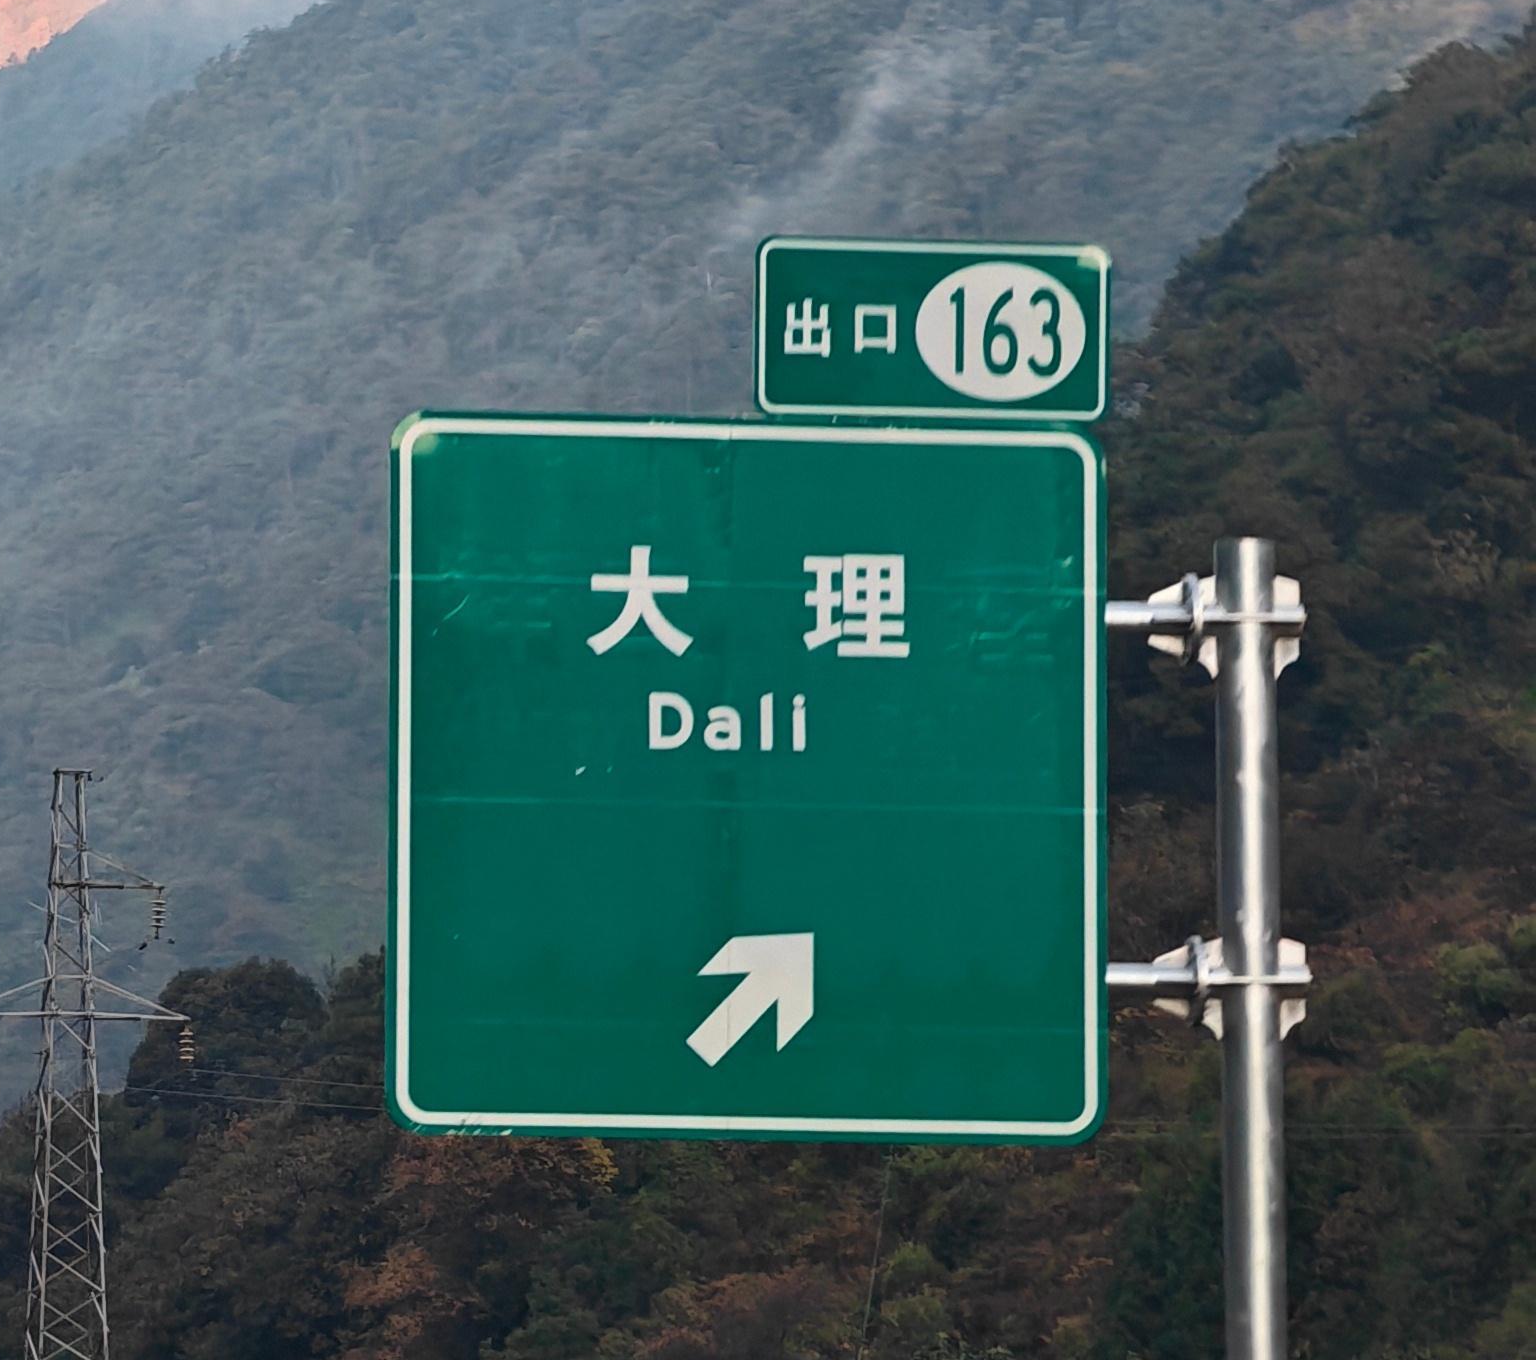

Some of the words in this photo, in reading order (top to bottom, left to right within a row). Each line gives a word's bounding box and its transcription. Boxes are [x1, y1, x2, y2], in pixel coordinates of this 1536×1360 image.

[784, 299, 896, 357] 出口
[950, 286, 1062, 377] 163
[587, 545, 910, 659] 大理
[649, 692, 807, 751] Dali
